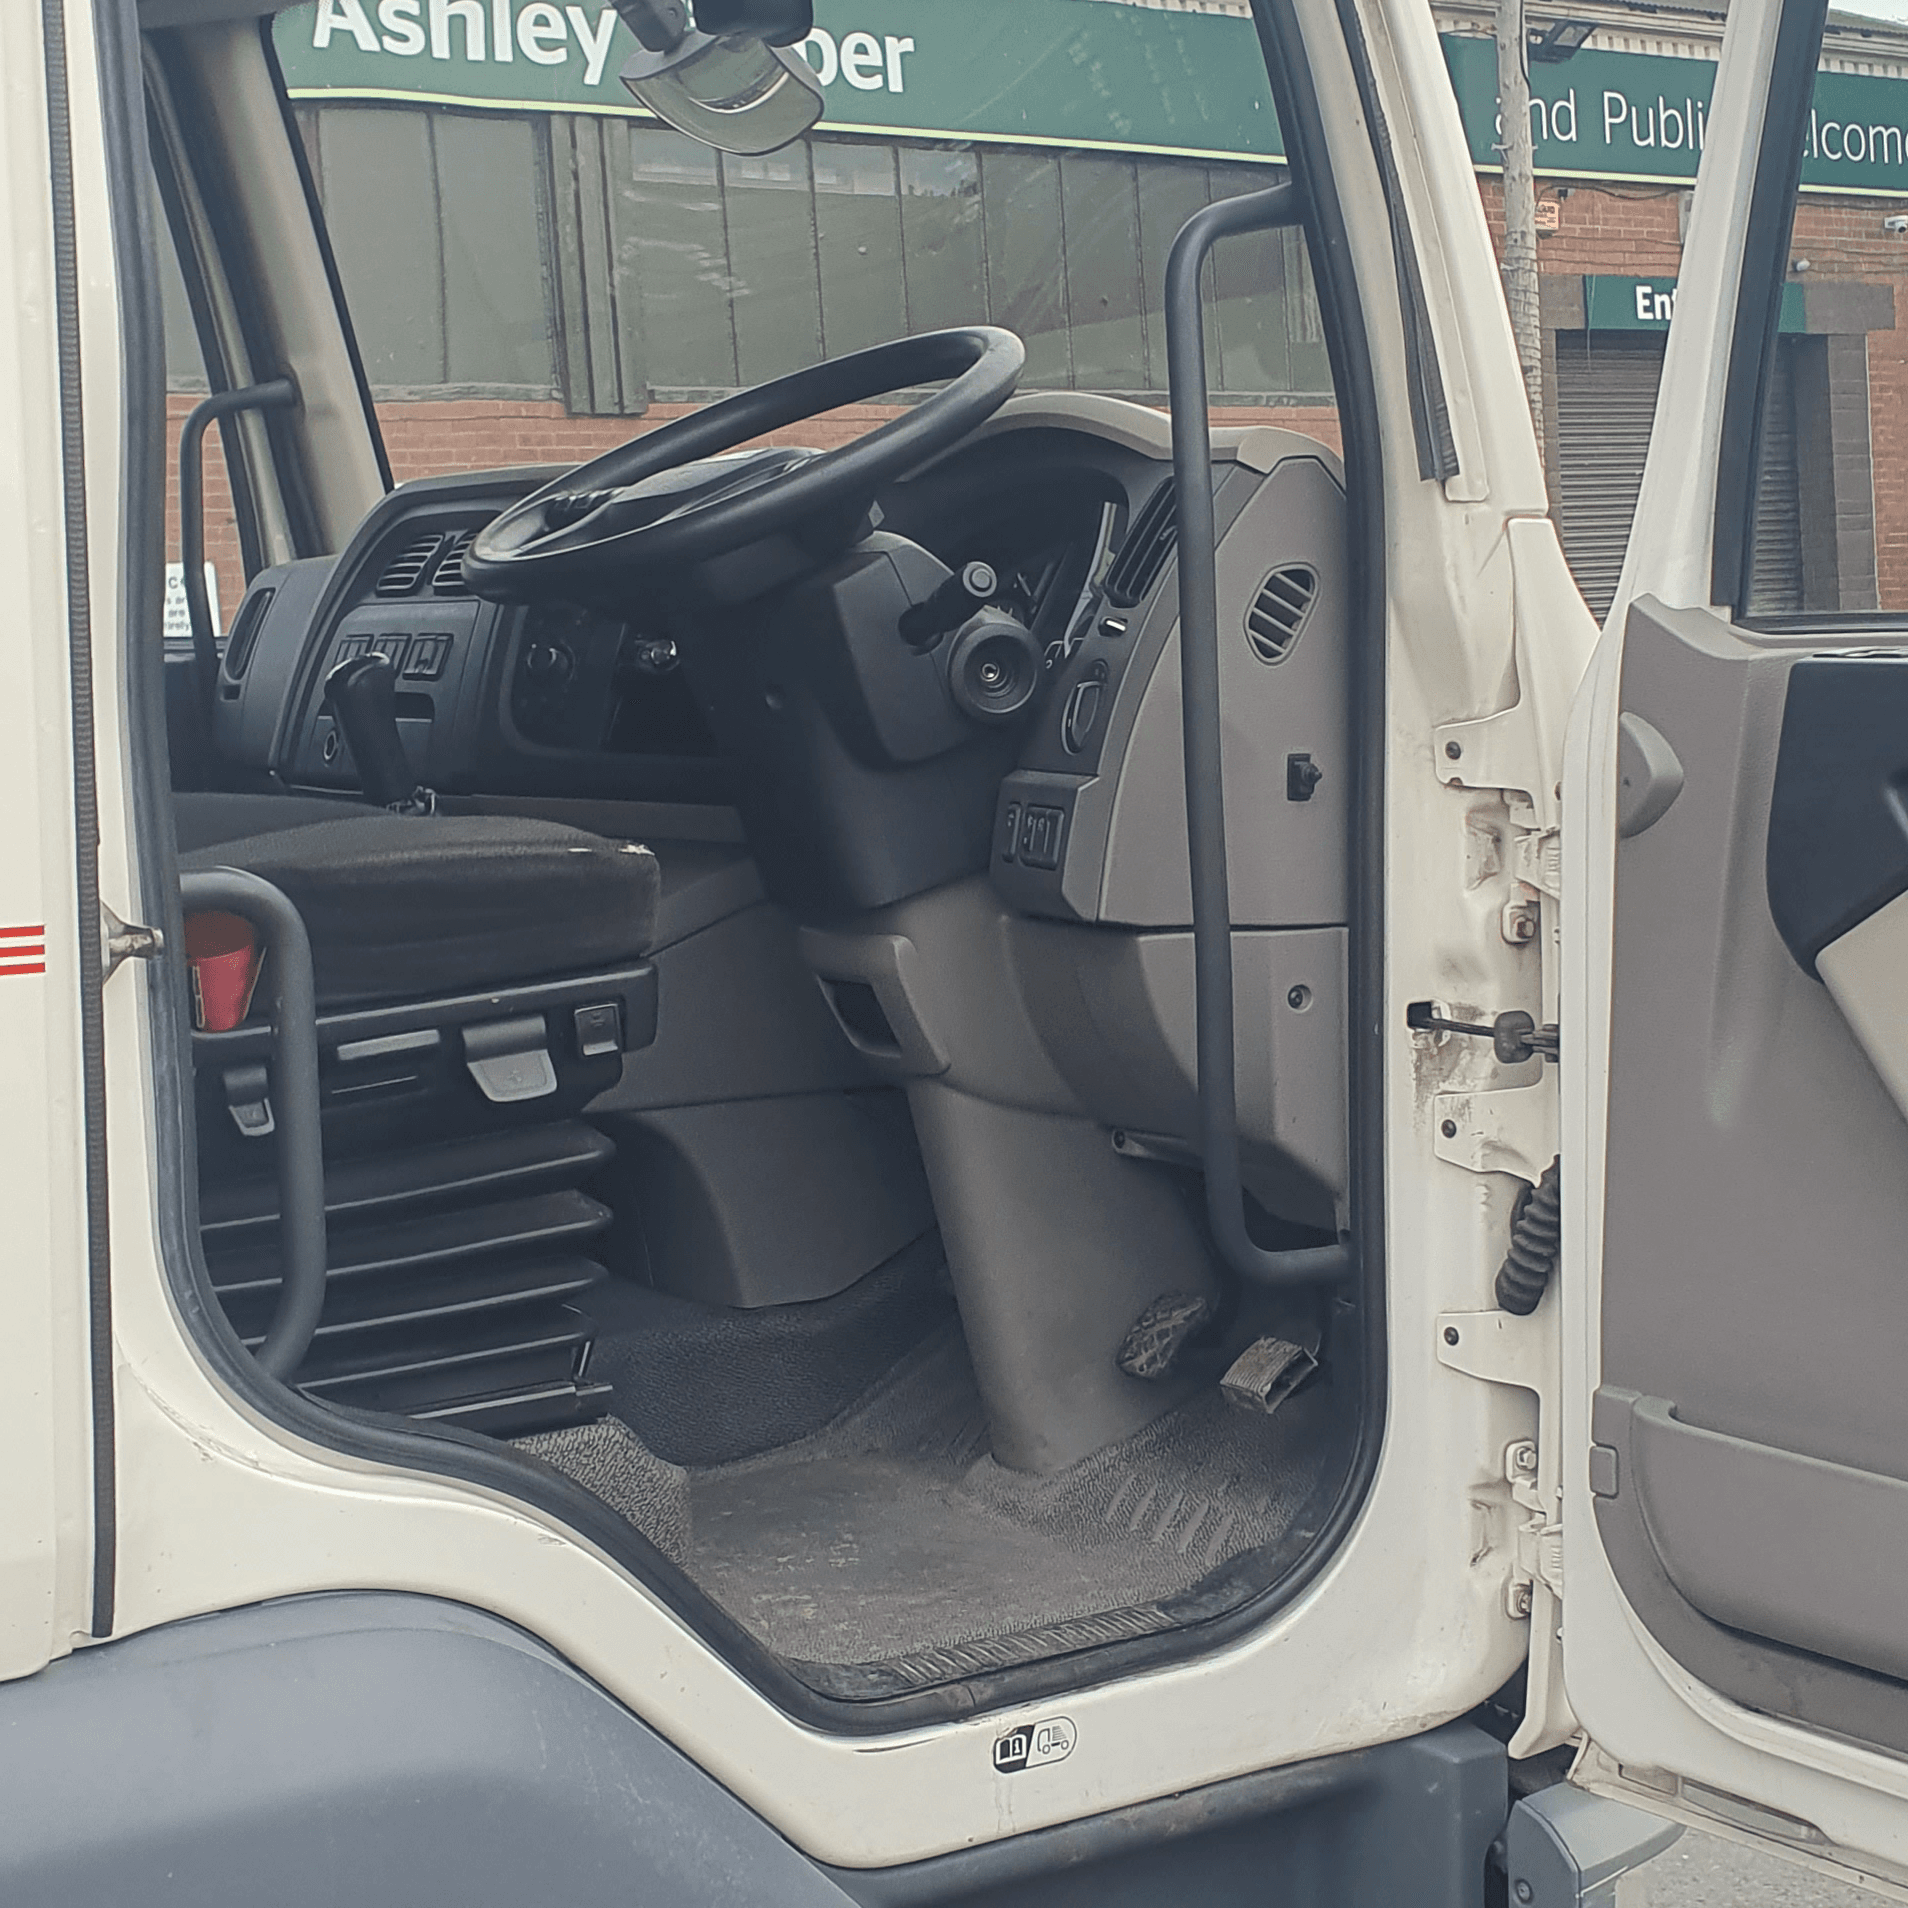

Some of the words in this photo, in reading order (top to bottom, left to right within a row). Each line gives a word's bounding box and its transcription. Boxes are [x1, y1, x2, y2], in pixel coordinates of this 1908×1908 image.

[313, 0, 618, 86] Ashley
[1603, 91, 1704, 151] Publi
[1803, 108, 1908, 165] lcom
